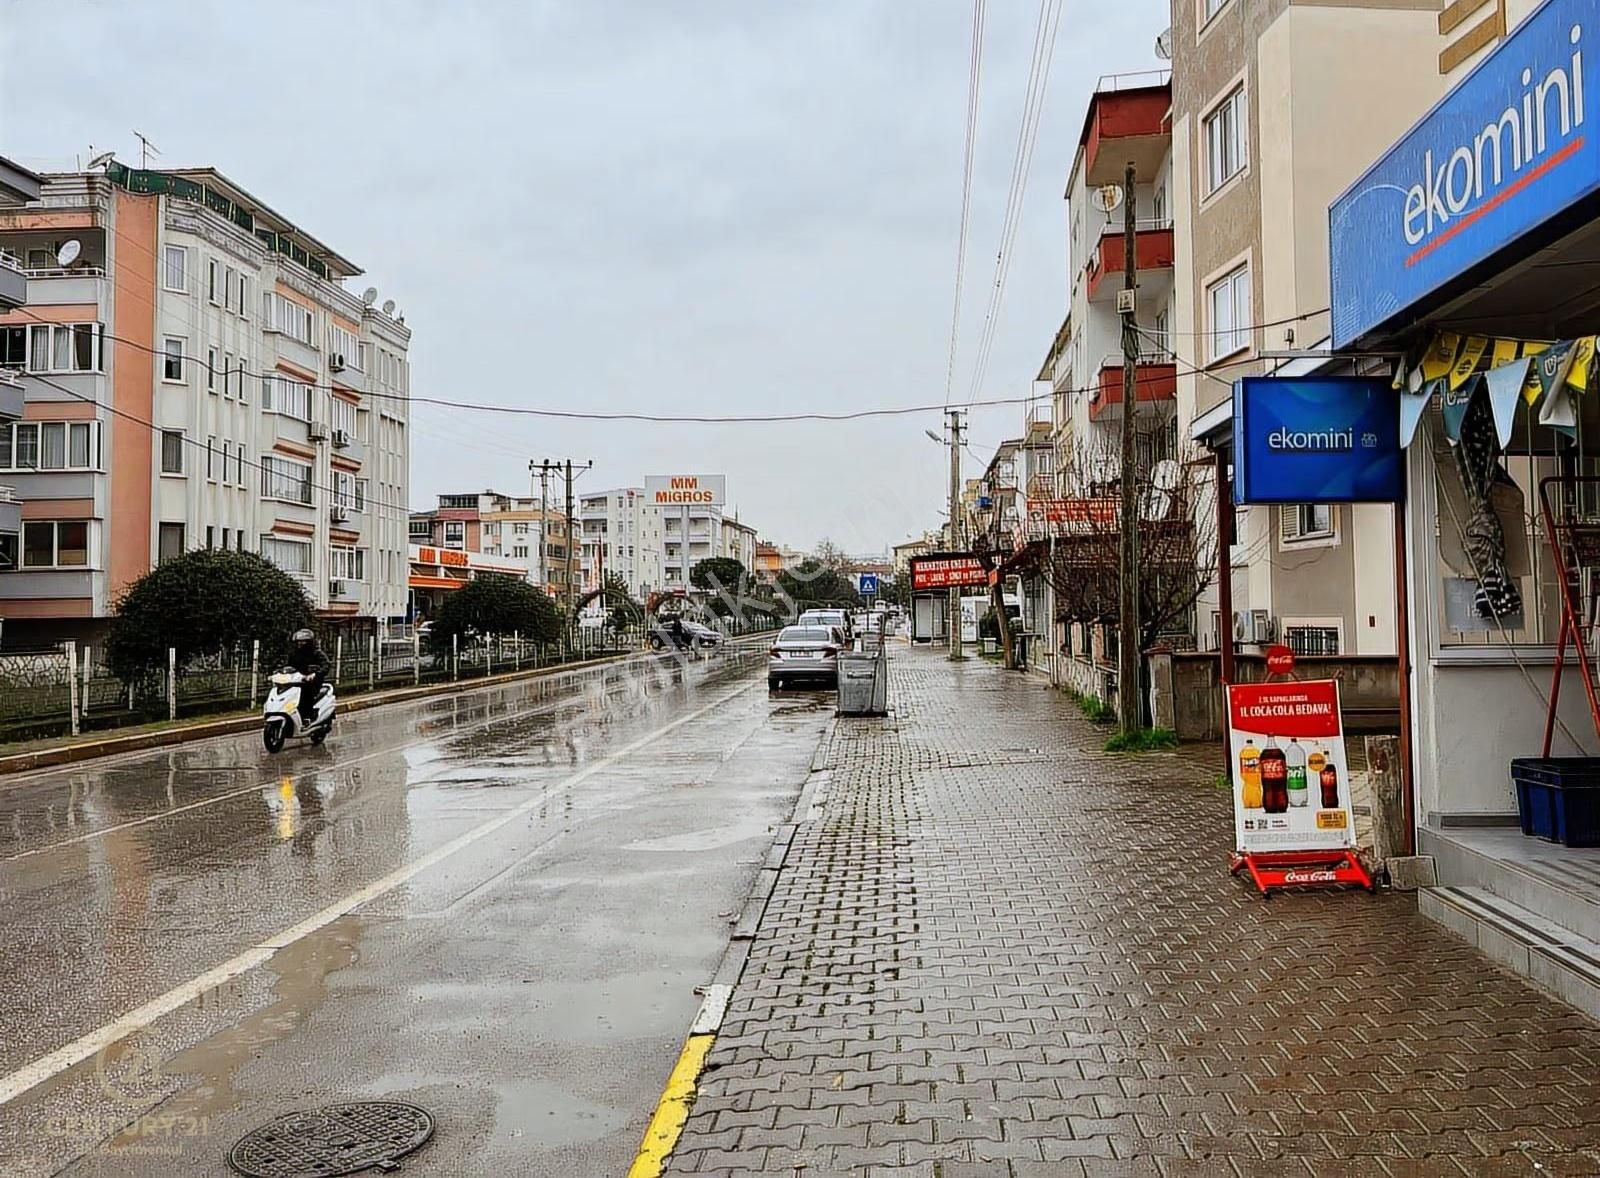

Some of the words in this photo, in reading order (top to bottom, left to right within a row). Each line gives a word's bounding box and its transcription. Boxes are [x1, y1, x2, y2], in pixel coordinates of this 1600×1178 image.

[1401, 23, 1585, 246] ekomini
[1267, 426, 1354, 450] ekomini
[671, 477, 698, 489] MM
[1296, 703, 1332, 715] BEDAVA!
